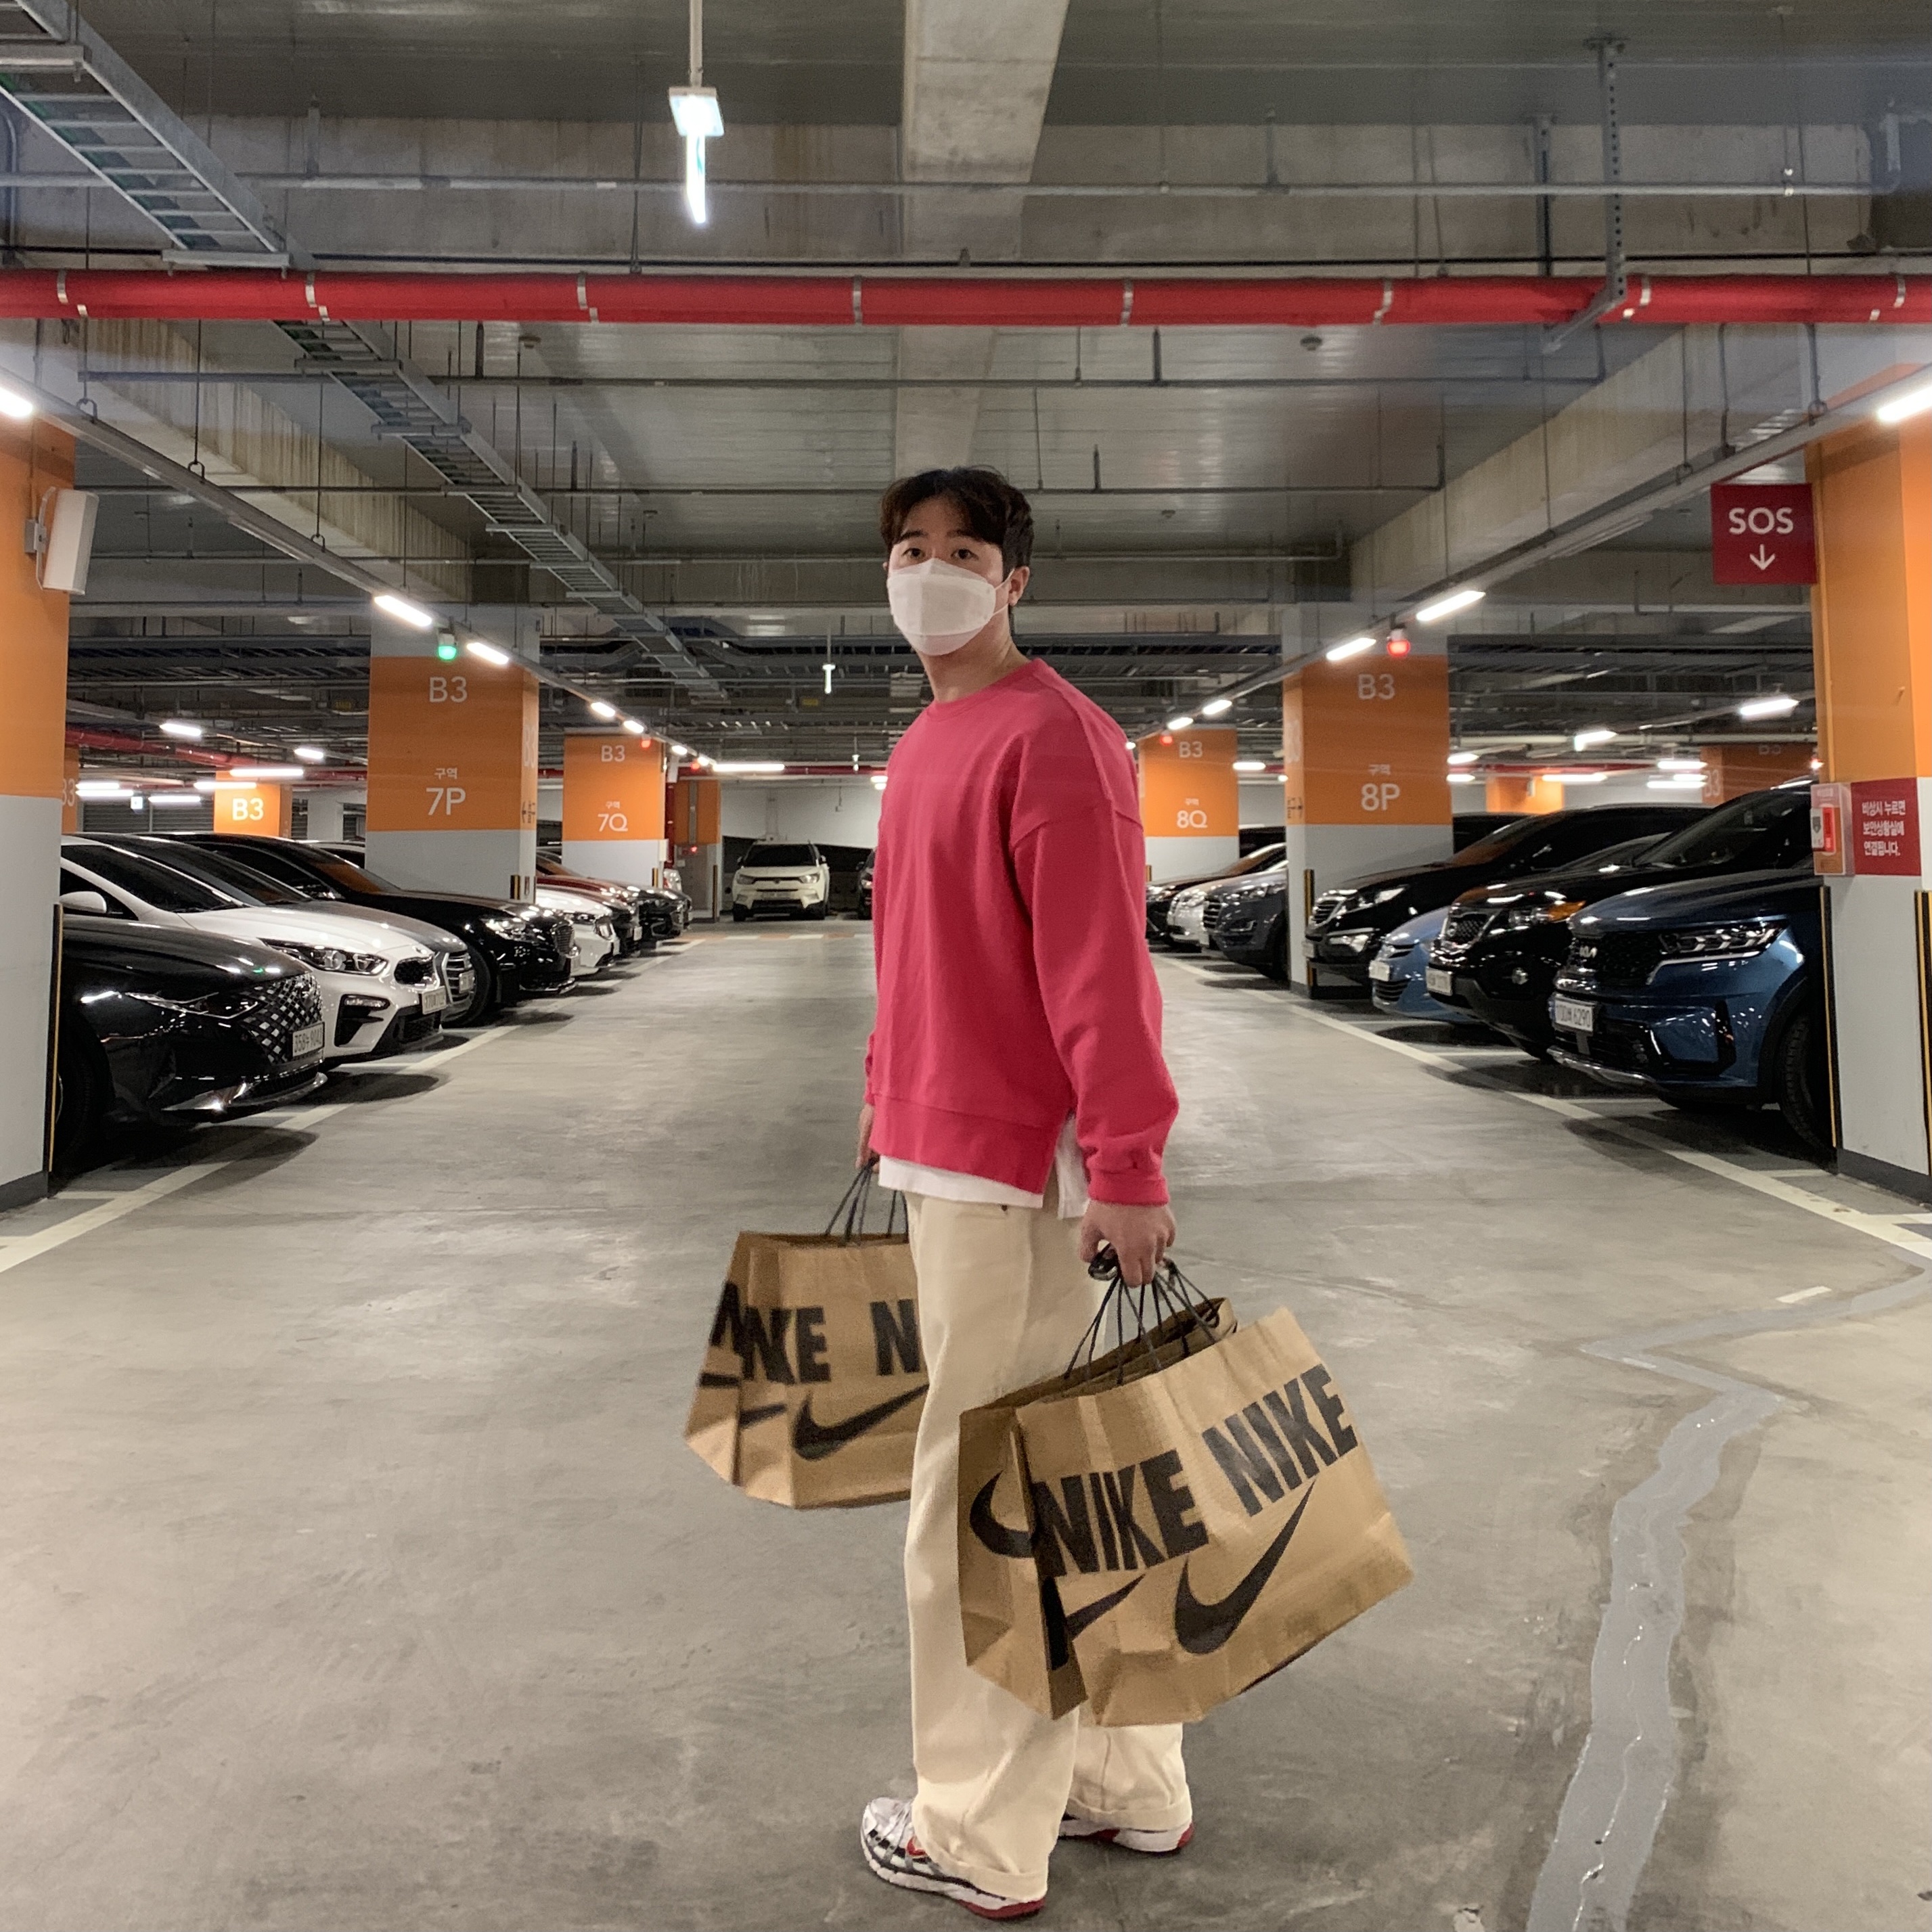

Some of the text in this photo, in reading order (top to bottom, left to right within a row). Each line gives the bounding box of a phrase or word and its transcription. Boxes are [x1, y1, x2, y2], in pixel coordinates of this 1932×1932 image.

[1729, 507, 1793, 535] SOS
[430, 676, 468, 702] B3
[1357, 673, 1395, 700] B3
[601, 745, 625, 762] B3
[1179, 741, 1203, 758] B3
[434, 767, 458, 780] 구역
[426, 788, 466, 815] 7P
[1361, 782, 1400, 811] 8P
[232, 798, 264, 821] B3
[1862, 799, 1906, 816] 비상시 누르면
[598, 813, 628, 832] 7Q
[1177, 810, 1208, 828] 8Q
[1863, 820, 1904, 836] 보안상황실에
[1864, 840, 1901, 856] 연결됩니다.
[1032, 1364, 1358, 1577] NIKE NIKE
